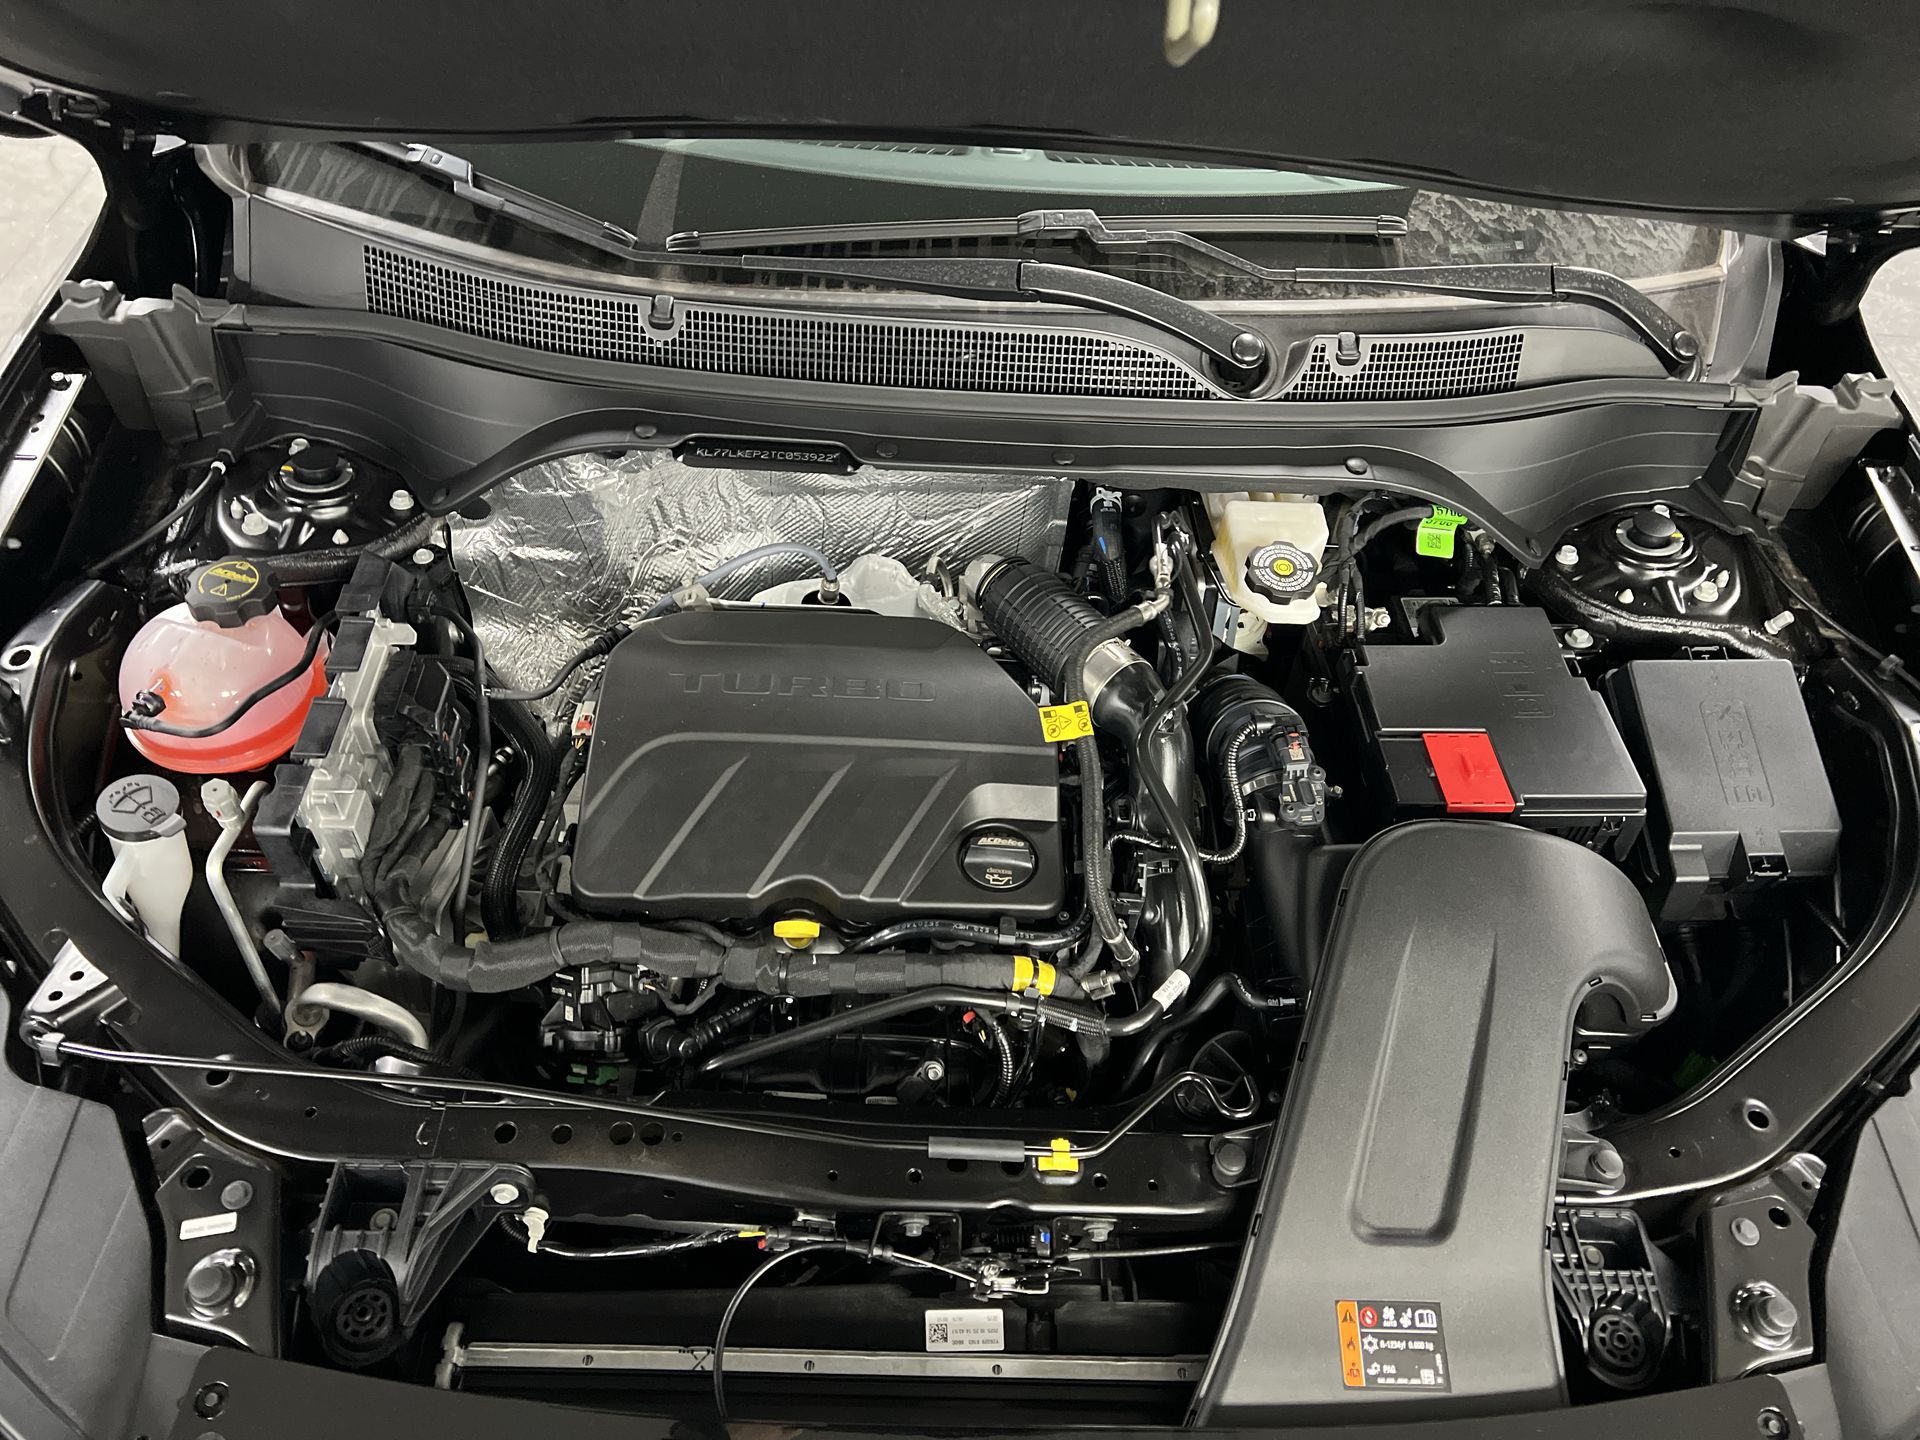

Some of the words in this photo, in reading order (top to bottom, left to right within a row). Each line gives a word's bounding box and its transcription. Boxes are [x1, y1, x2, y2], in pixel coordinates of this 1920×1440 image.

[696, 447, 834, 463] KL77LKEP2TC053922
[668, 672, 937, 702] TURBO
[977, 837, 1025, 848] ACDelco
